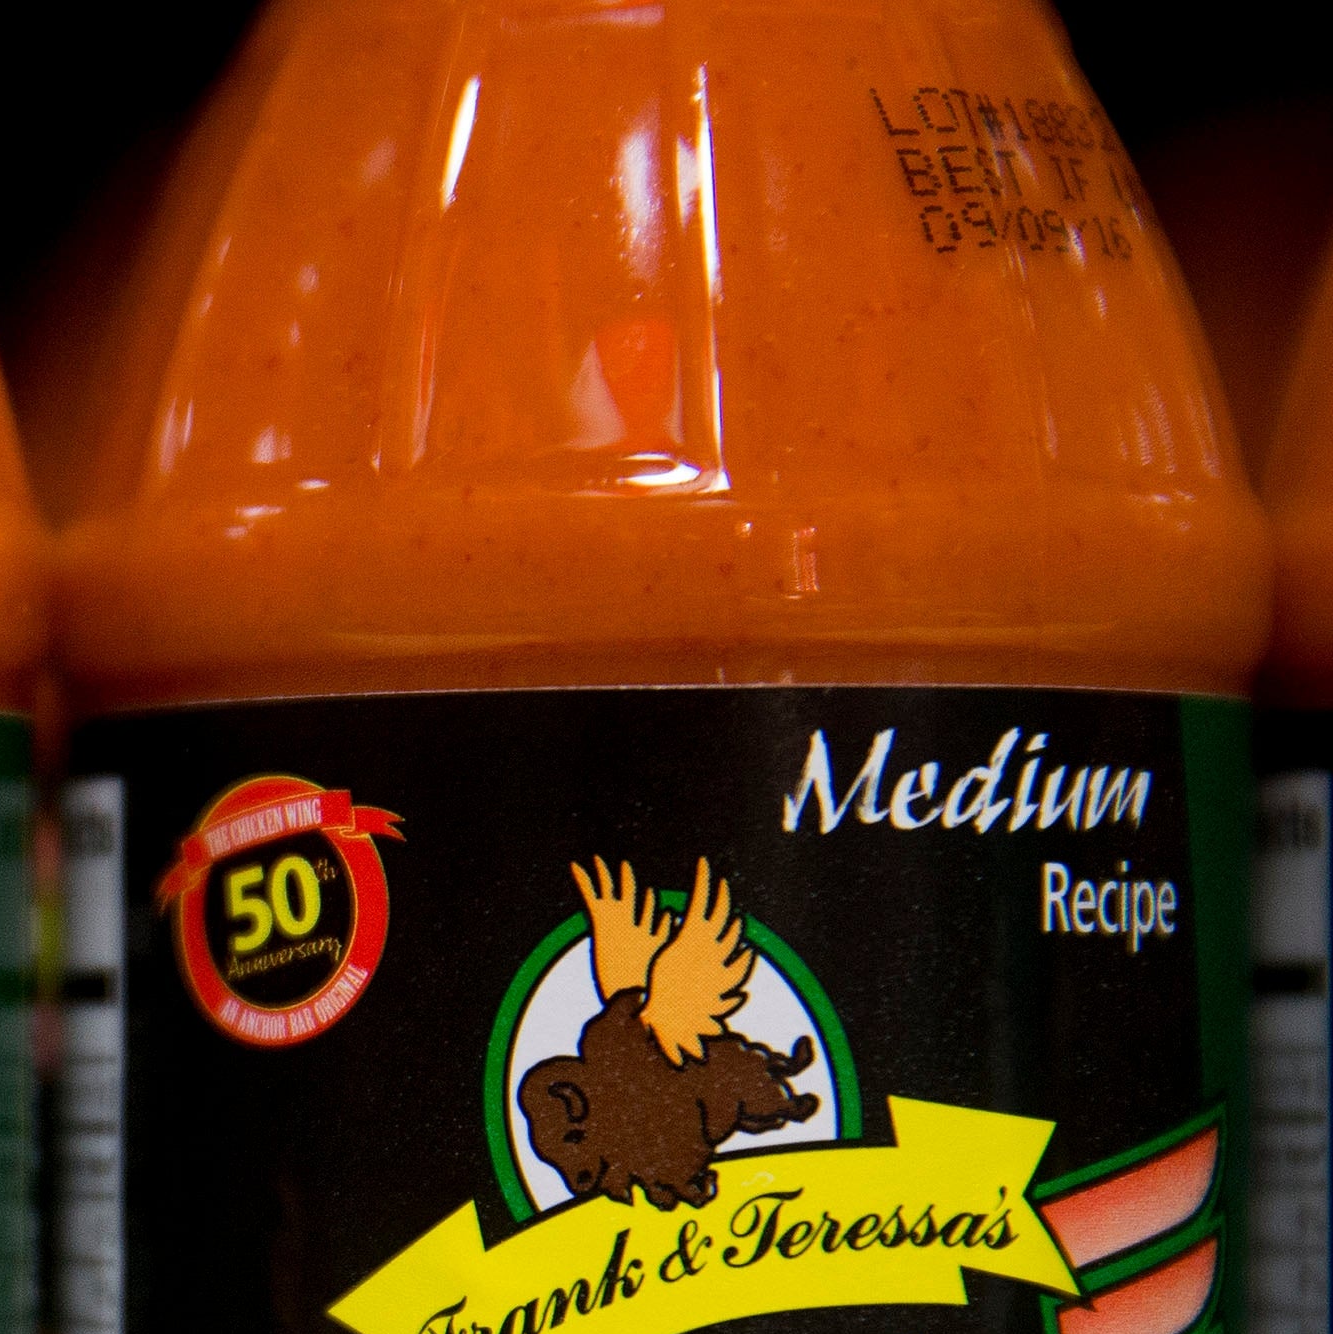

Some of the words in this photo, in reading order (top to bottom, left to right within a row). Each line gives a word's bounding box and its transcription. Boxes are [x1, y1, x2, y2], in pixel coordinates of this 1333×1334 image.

[896, 146, 1022, 197] BEST
[1049, 155, 1089, 201] IF
[285, 797, 323, 828] WING
[782, 727, 1151, 835] Medium
[1041, 860, 1177, 952] Recipe
[228, 936, 342, 980] Anniversary
[288, 1007, 318, 1038] BAR
[312, 963, 369, 1024] ORIGINAL
[658, 1220, 713, 1284] &
[722, 1186, 1020, 1268] Teressa's
